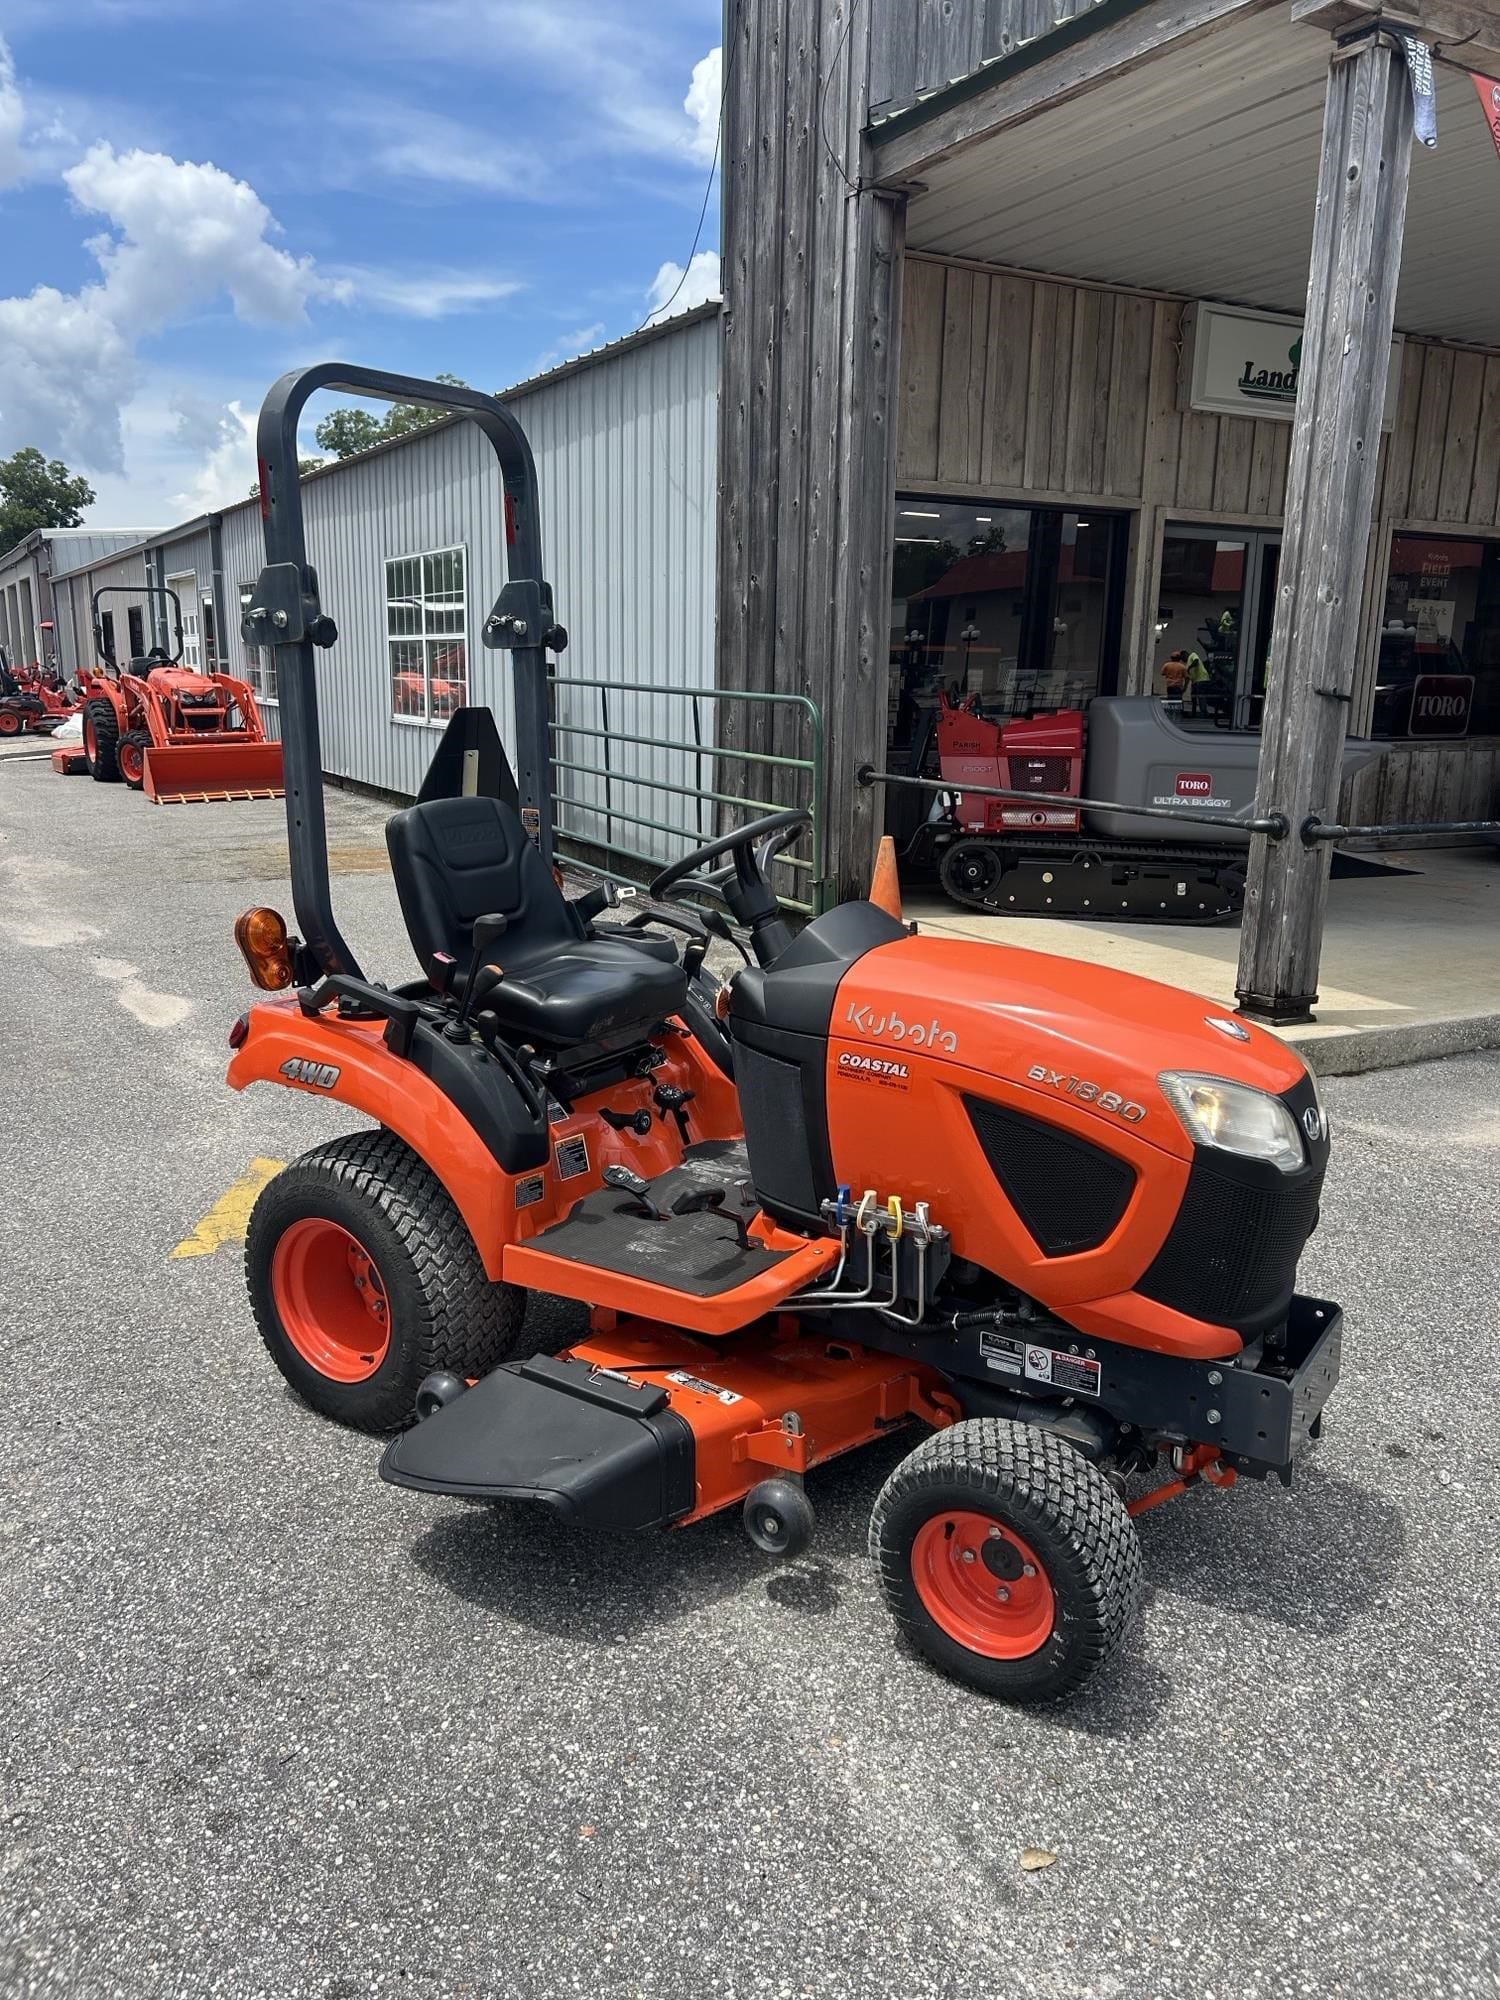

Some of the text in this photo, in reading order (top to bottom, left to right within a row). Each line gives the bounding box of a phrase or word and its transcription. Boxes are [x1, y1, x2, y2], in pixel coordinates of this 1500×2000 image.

[1420, 576, 1449, 588] EVENT
[1417, 695, 1466, 717] TORO
[1178, 780, 1208, 790] TORO
[1153, 796, 1230, 807] ULTRA BUGGY
[846, 1002, 958, 1053] Kubota
[279, 1056, 342, 1089] 4WD
[839, 1052, 909, 1078] COASTAL
[1026, 1064, 1148, 1124] BX1880
